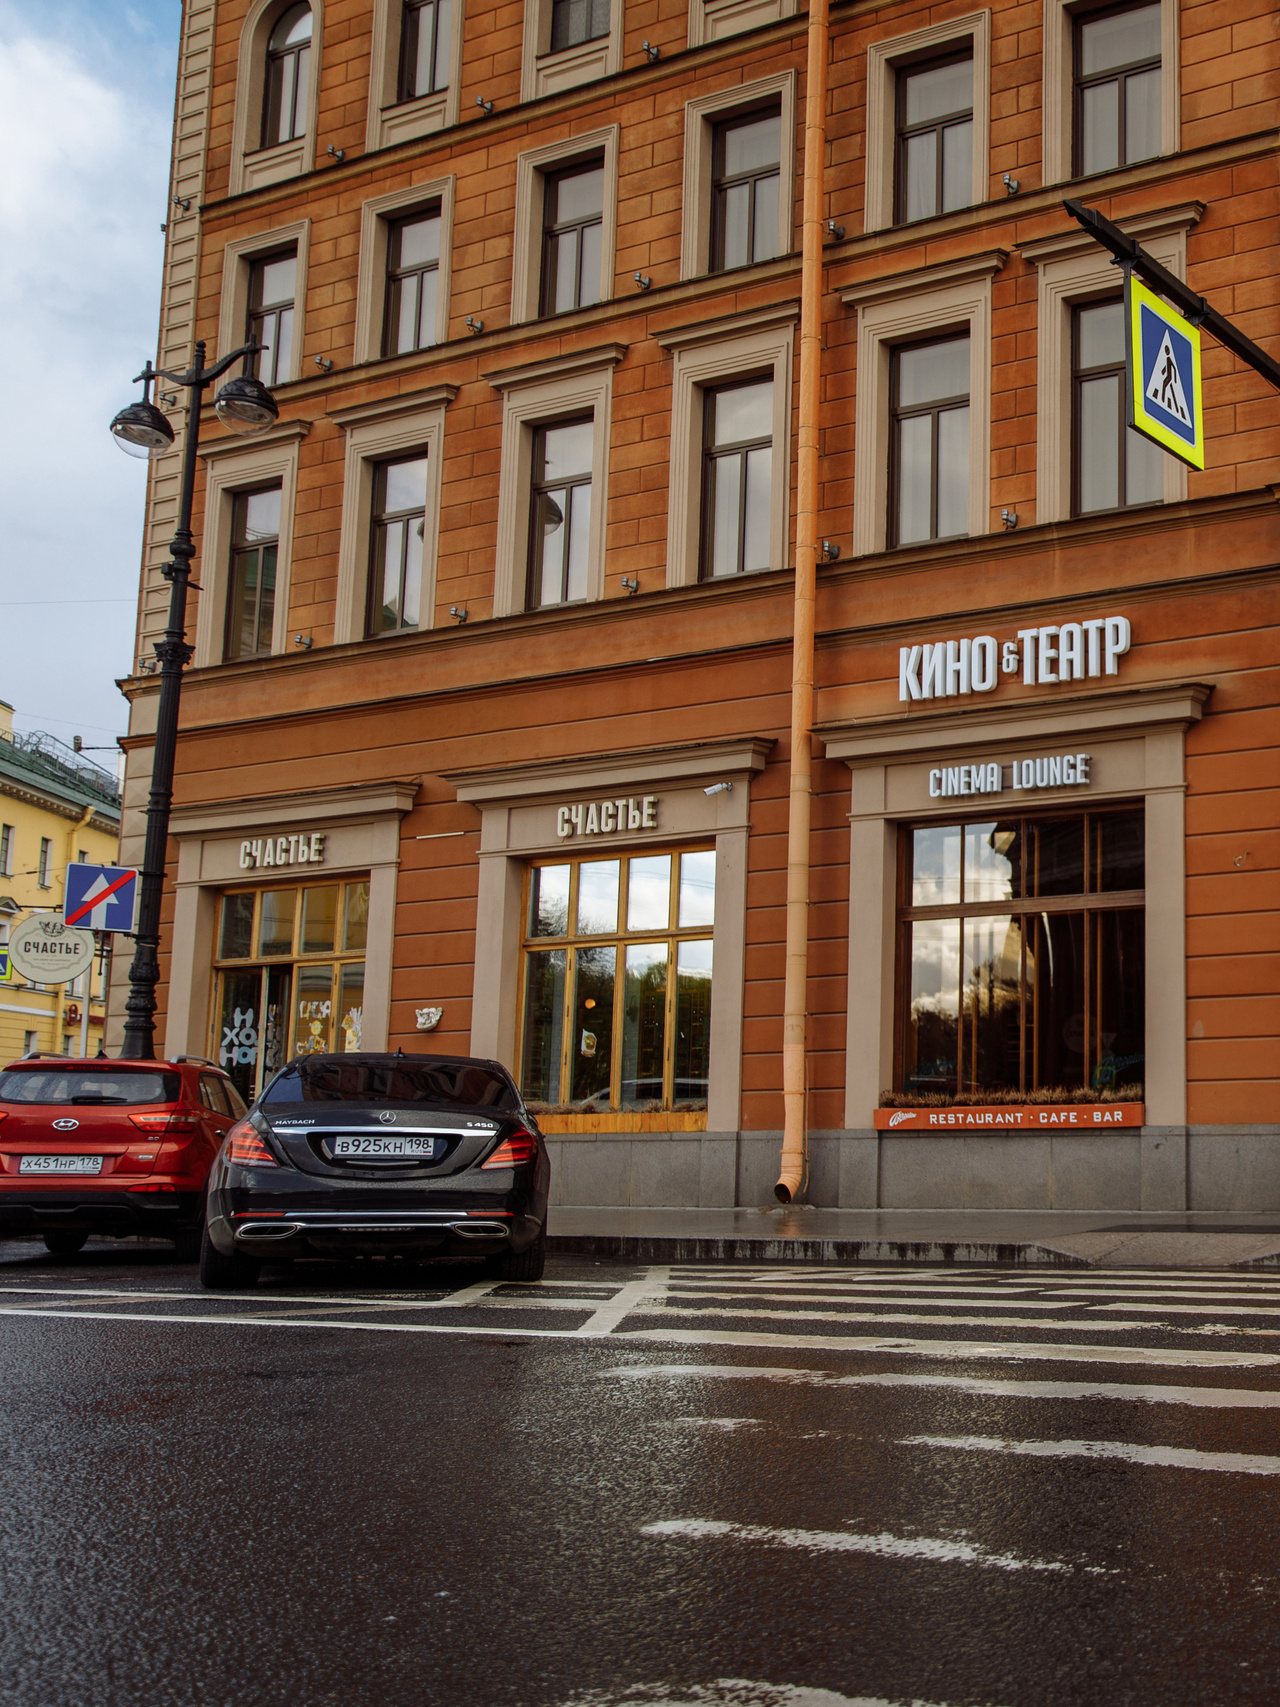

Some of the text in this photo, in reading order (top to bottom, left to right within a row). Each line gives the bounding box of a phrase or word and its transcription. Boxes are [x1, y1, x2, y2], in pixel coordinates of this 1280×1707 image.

[929, 754, 1091, 797] CINEMA LOUNGE
[557, 796, 657, 838] СЧАСТЬЕ
[240, 833, 325, 869] СЧАСТЬЕ
[24, 941, 80, 954] СЧАСТЬЕ
[929, 1113, 1023, 1125] RESTAURANT
[1039, 1112, 1078, 1123] CAFE
[1093, 1111, 1123, 1122] BAR
[406, 1138, 430, 1150] 198
[80, 1157, 99, 1166] 178
